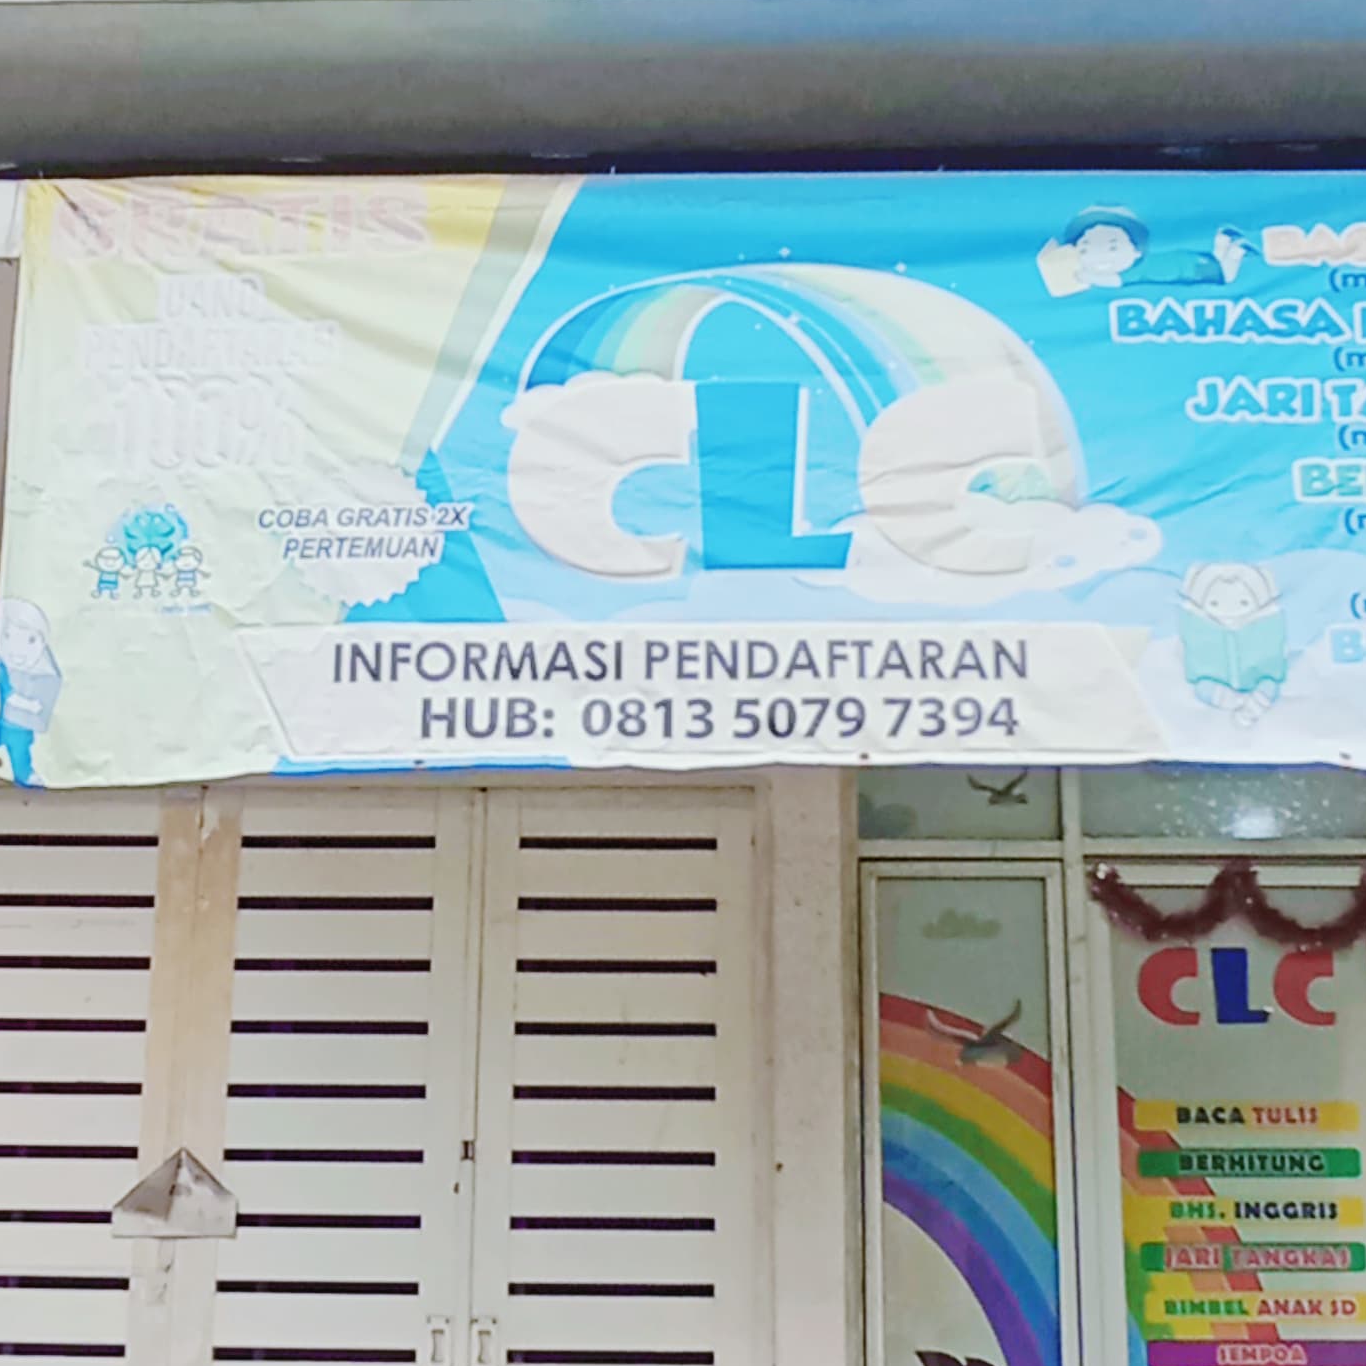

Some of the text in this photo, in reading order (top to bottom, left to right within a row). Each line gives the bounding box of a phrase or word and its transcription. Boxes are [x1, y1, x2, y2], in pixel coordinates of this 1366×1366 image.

[1115, 303, 1347, 338] BAHASA
[1191, 381, 1317, 418] JARI
[509, 377, 1043, 578] CLC
[259, 506, 467, 528] COBA GRATIS 2X
[283, 537, 439, 559] PERTEMUAN
[334, 639, 1027, 682] INFORMASI PENDAFTARAN
[421, 697, 1019, 739] HUB: 0813 5079 7394
[1138, 947, 1335, 1026] CLC
[1176, 1107, 1318, 1124] BACA TULIS
[1180, 1154, 1325, 1172] BERHITUNG
[1234, 1201, 1338, 1219] INGGRIS
[1166, 1248, 1348, 1267] JARI TANGKAS
[1164, 1300, 1357, 1316] BIMBEL ANAK SD
[1218, 1345, 1307, 1365] SEMPOA
